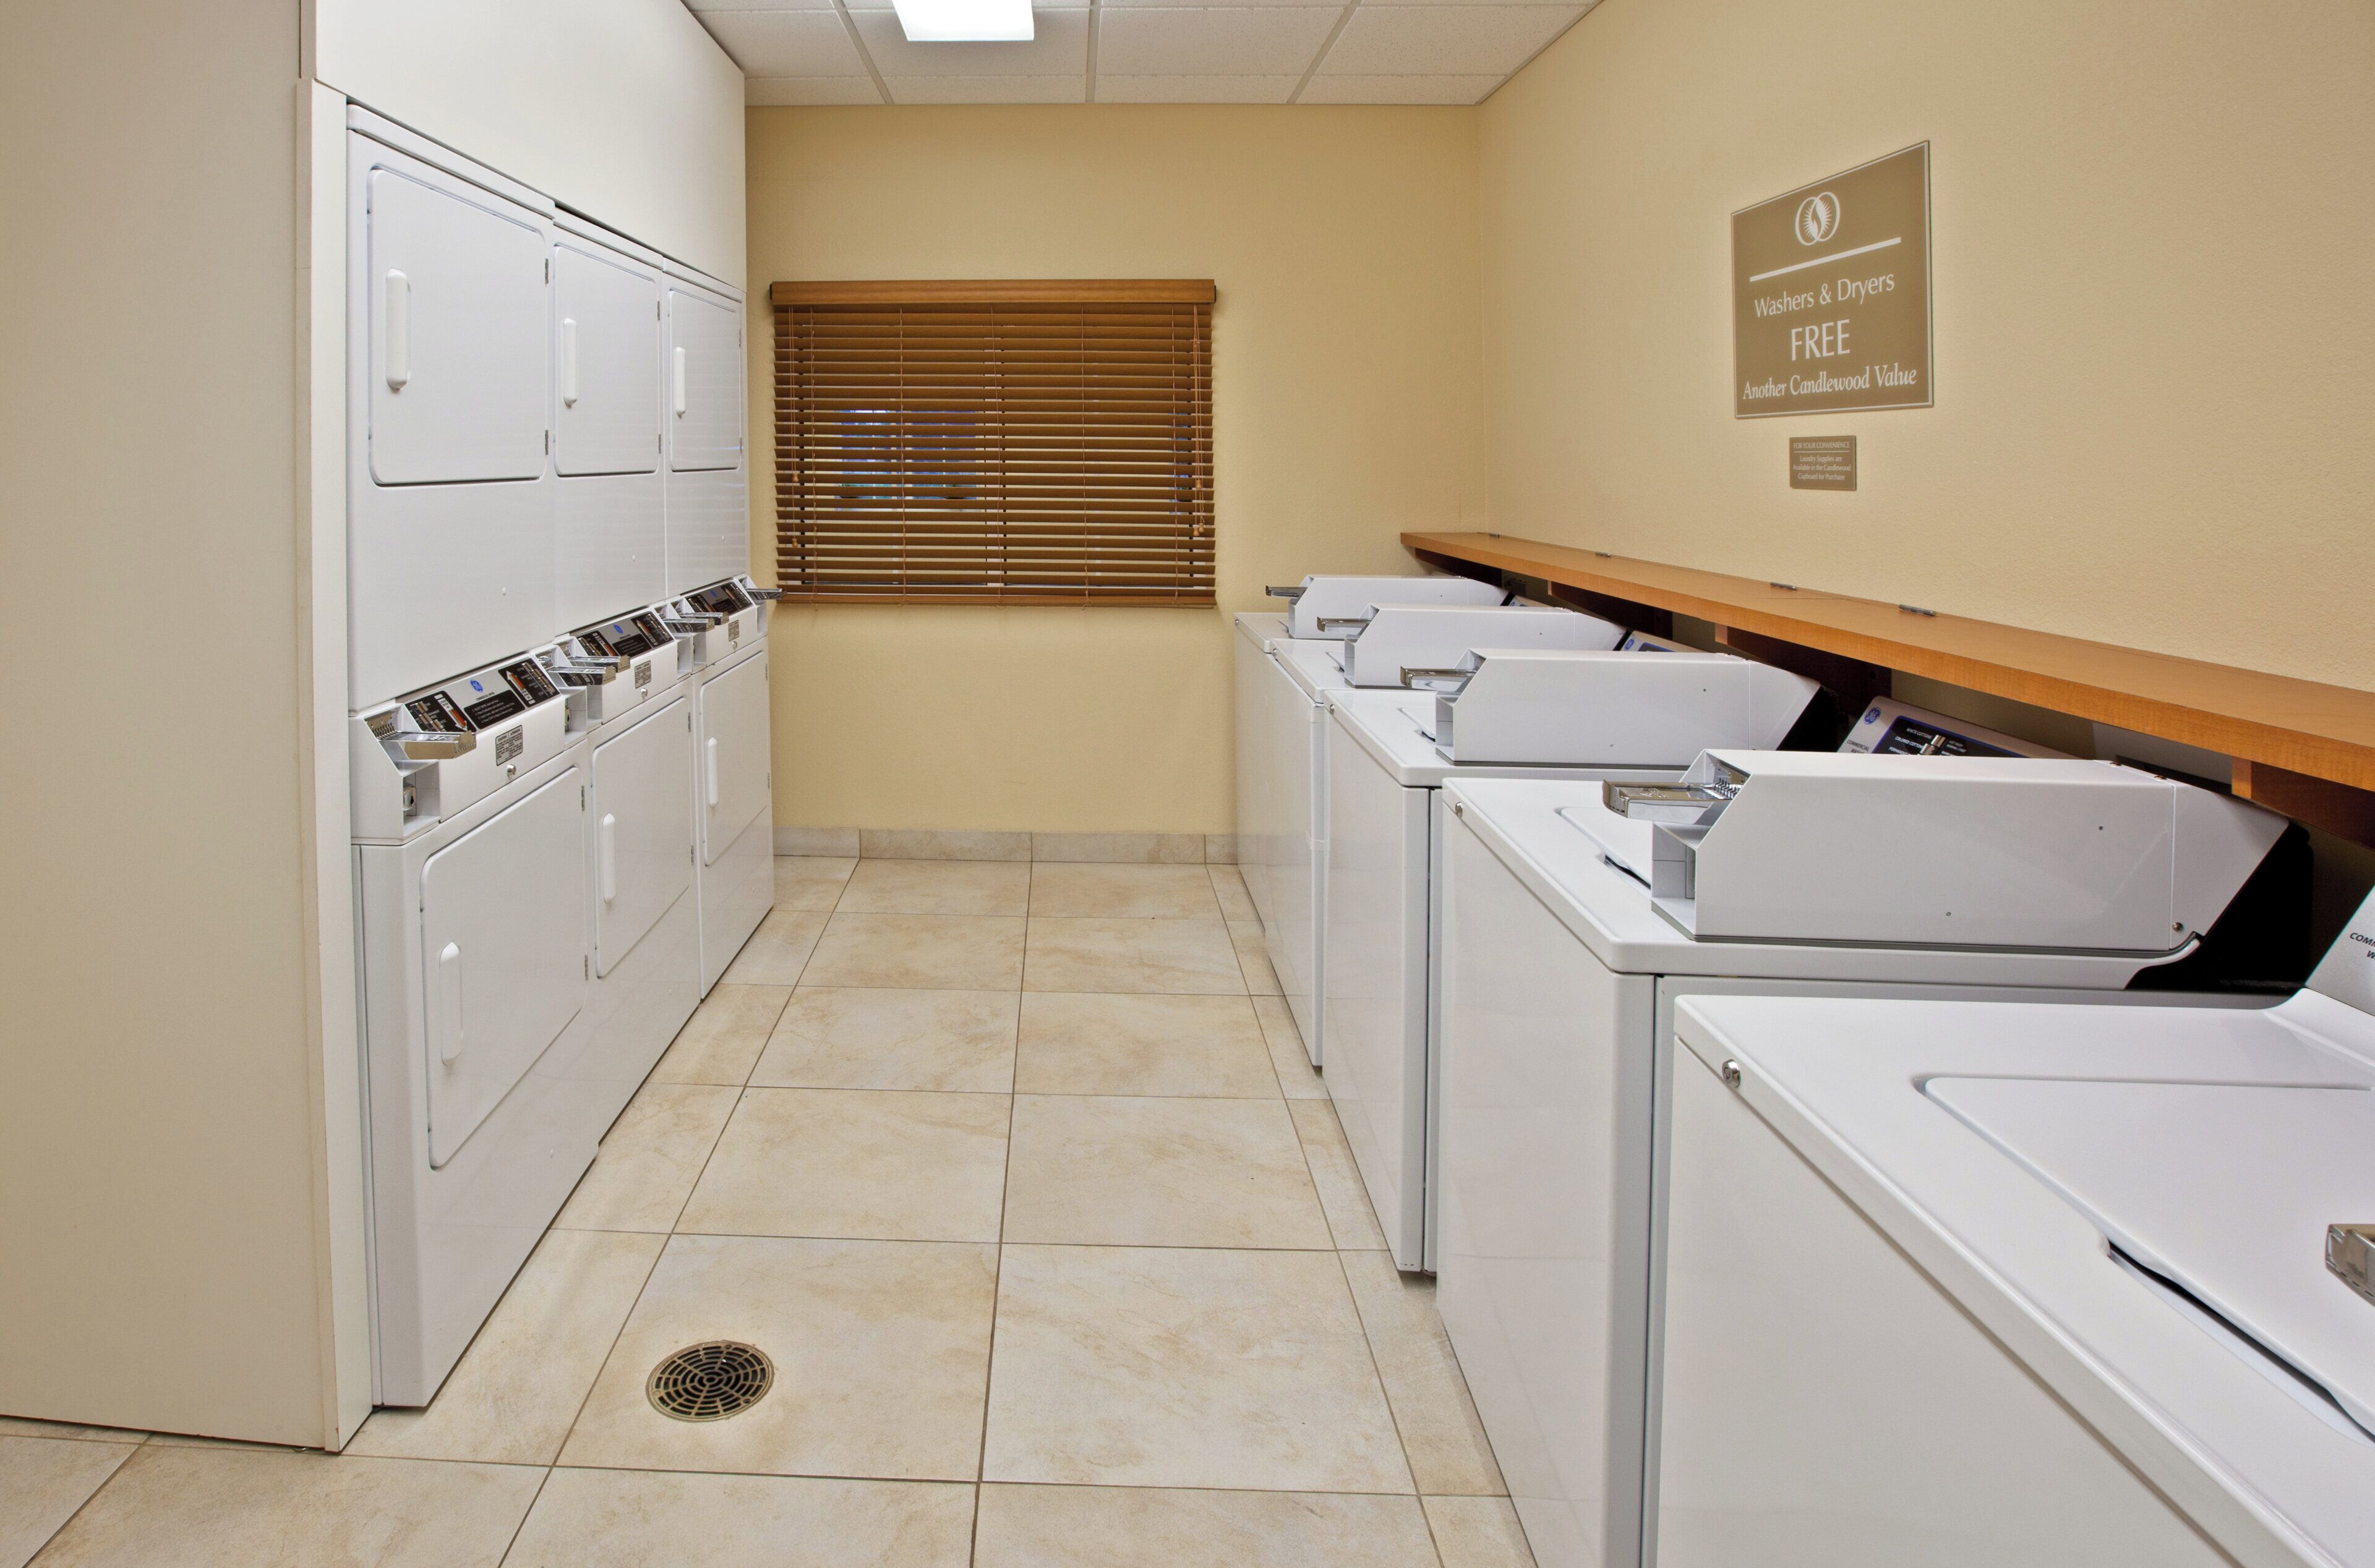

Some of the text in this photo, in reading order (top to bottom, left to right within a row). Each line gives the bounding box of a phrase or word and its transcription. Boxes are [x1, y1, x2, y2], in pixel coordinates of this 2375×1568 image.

[1754, 273, 1894, 318] Washers & Dryers
[1791, 318, 1851, 361] FREE
[1743, 362, 1917, 399] Another Candlewood Value
